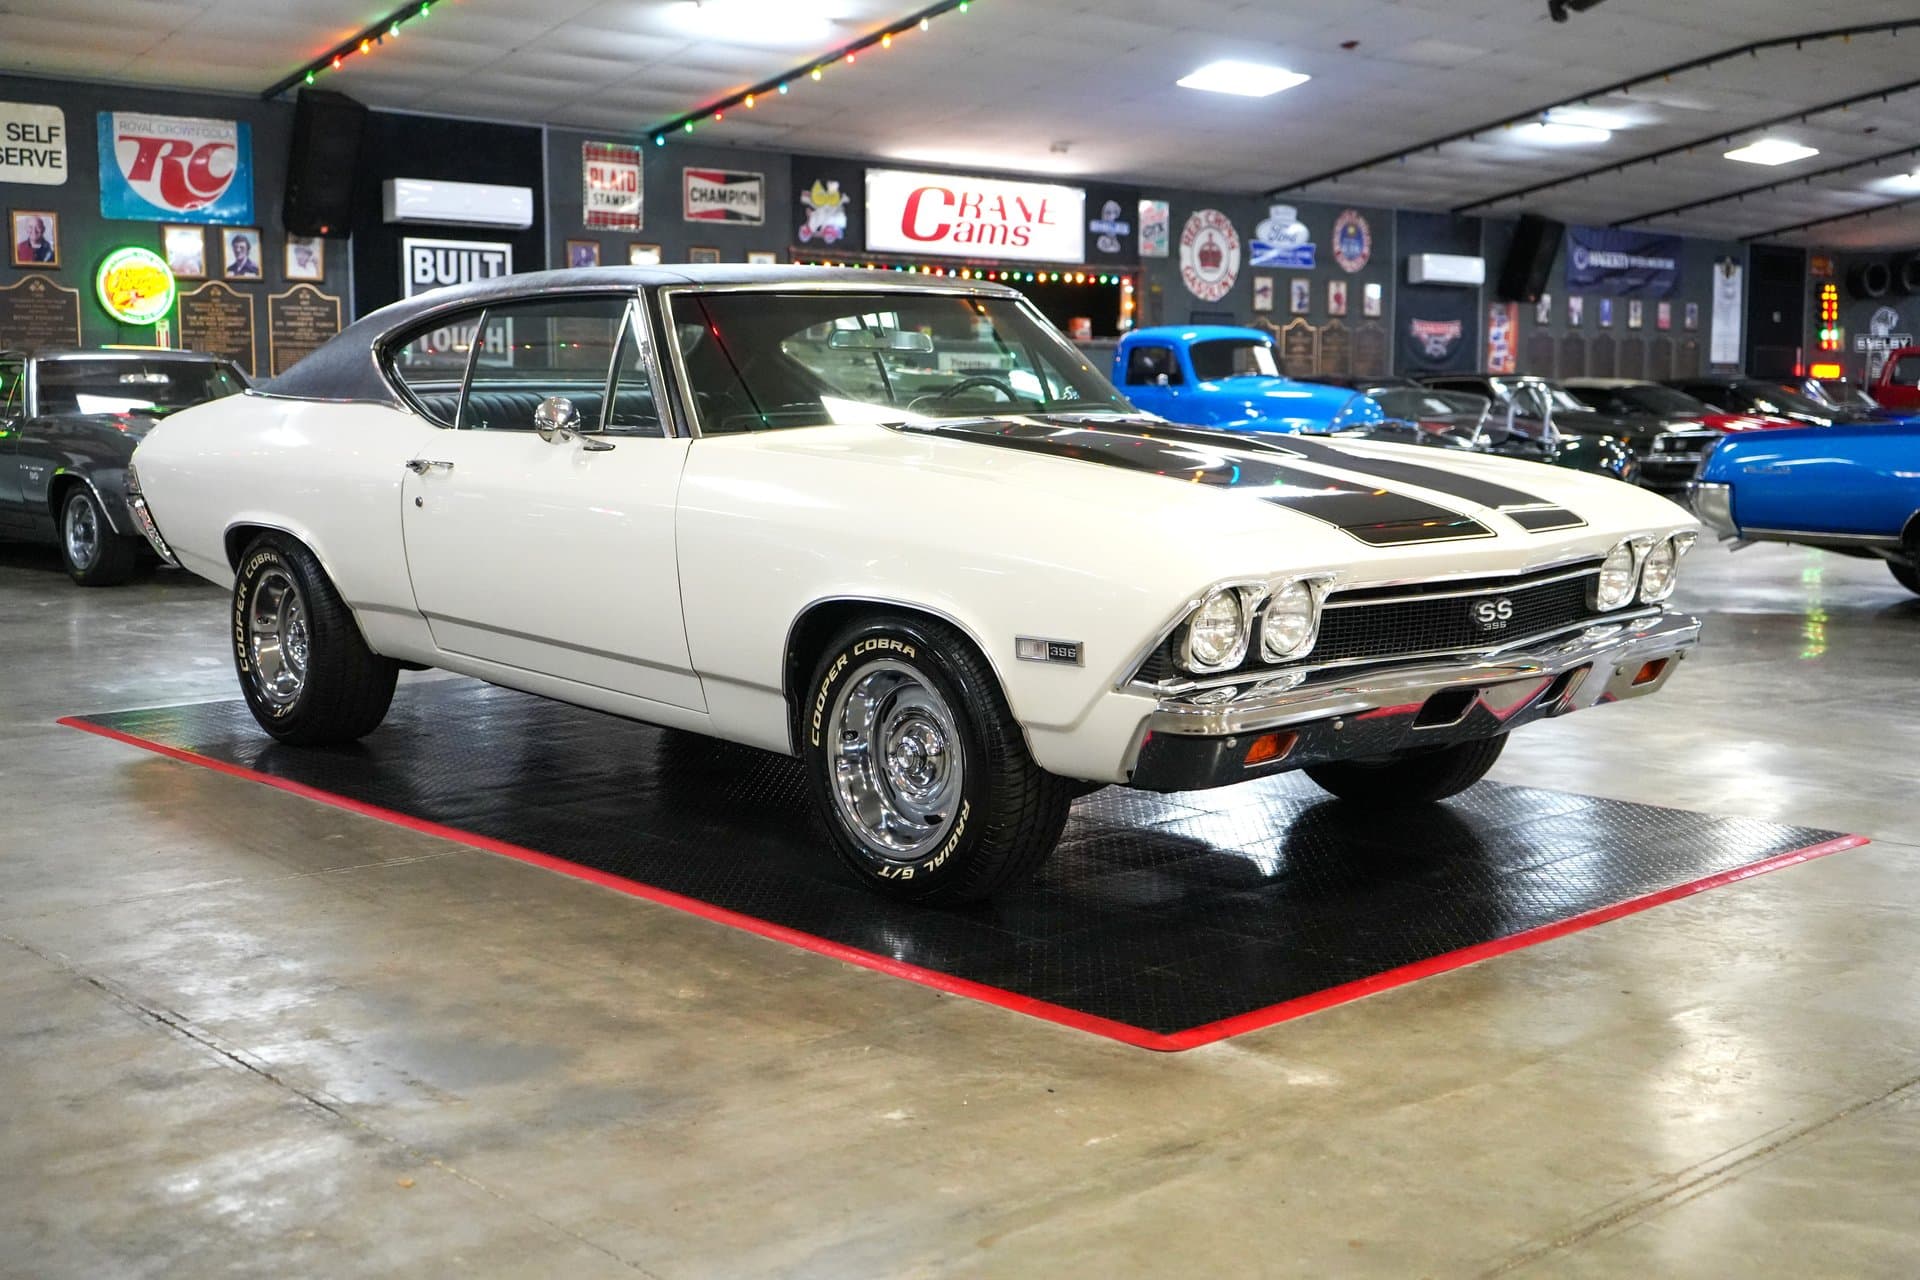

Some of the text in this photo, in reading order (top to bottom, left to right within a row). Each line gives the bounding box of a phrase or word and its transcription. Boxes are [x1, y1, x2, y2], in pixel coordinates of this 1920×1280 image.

[6, 122, 61, 144] SELF
[119, 119, 155, 134] ROYAL
[118, 135, 235, 209] RC
[590, 167, 637, 193] PLAID
[690, 186, 758, 206] CHAMPION
[235, 552, 279, 672] COOPER COBRA
[1478, 600, 1513, 622] SS
[1483, 621, 1507, 631] 396
[1049, 646, 1077, 658] 396
[811, 638, 917, 747] COOPER COBRA
[877, 799, 971, 880] RADIAL G/T
